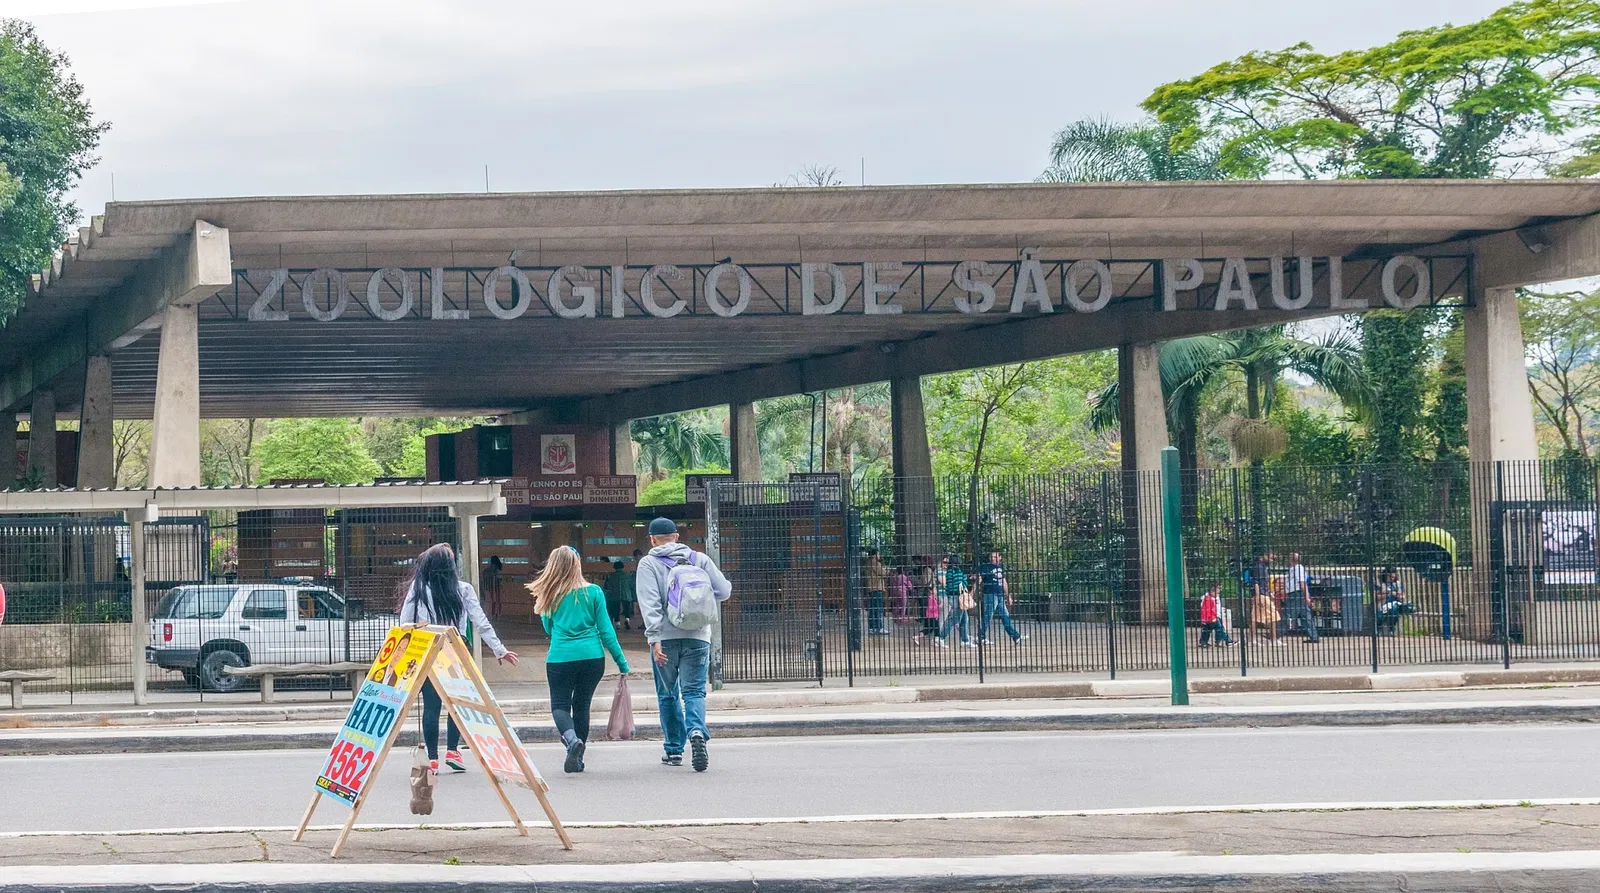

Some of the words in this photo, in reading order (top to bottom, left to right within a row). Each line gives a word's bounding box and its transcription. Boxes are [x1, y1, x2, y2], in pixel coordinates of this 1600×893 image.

[247, 250, 752, 322] ZOOLÓGICO
[801, 262, 904, 316] DE
[953, 246, 1113, 314] SÃO
[1162, 255, 1430, 312] PAULO
[543, 491, 561, 501] SÃO
[558, 480, 570, 488] DO
[324, 740, 375, 791] 1562
